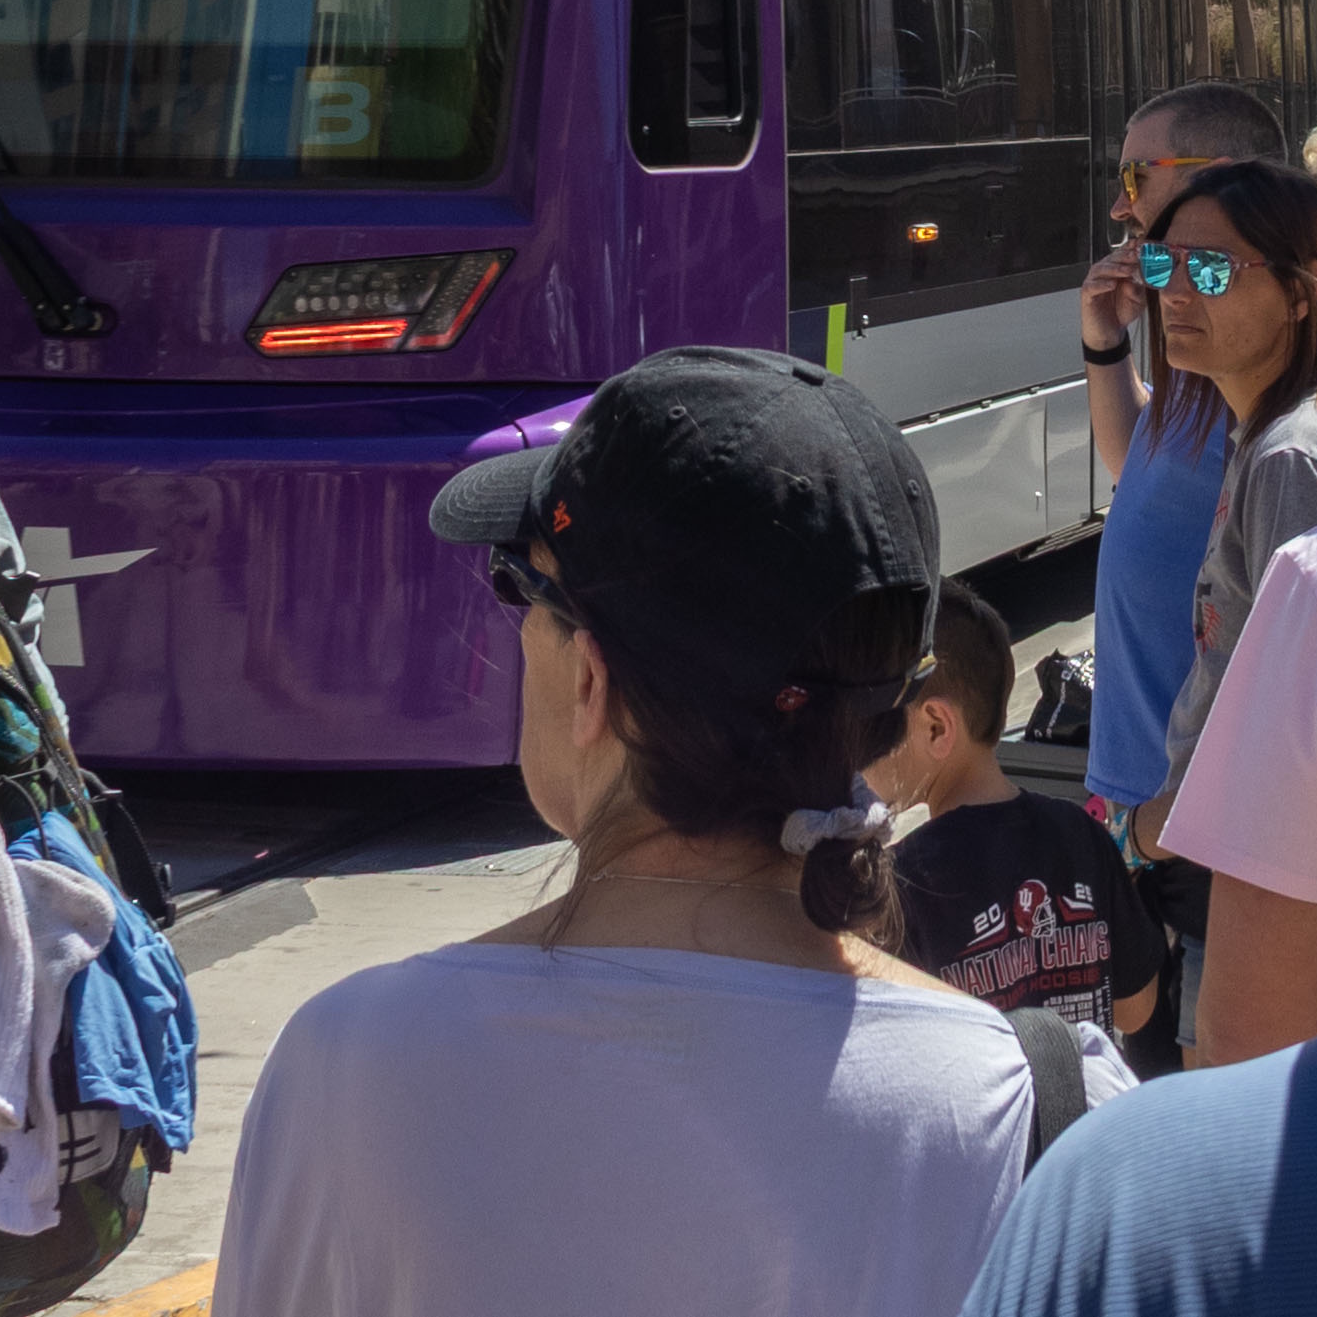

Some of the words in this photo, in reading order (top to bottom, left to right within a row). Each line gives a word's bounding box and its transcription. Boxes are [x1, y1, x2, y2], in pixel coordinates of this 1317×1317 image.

[300, 81, 372, 145] B
[973, 902, 1002, 935] 20
[940, 935, 1037, 997] NATIAL
